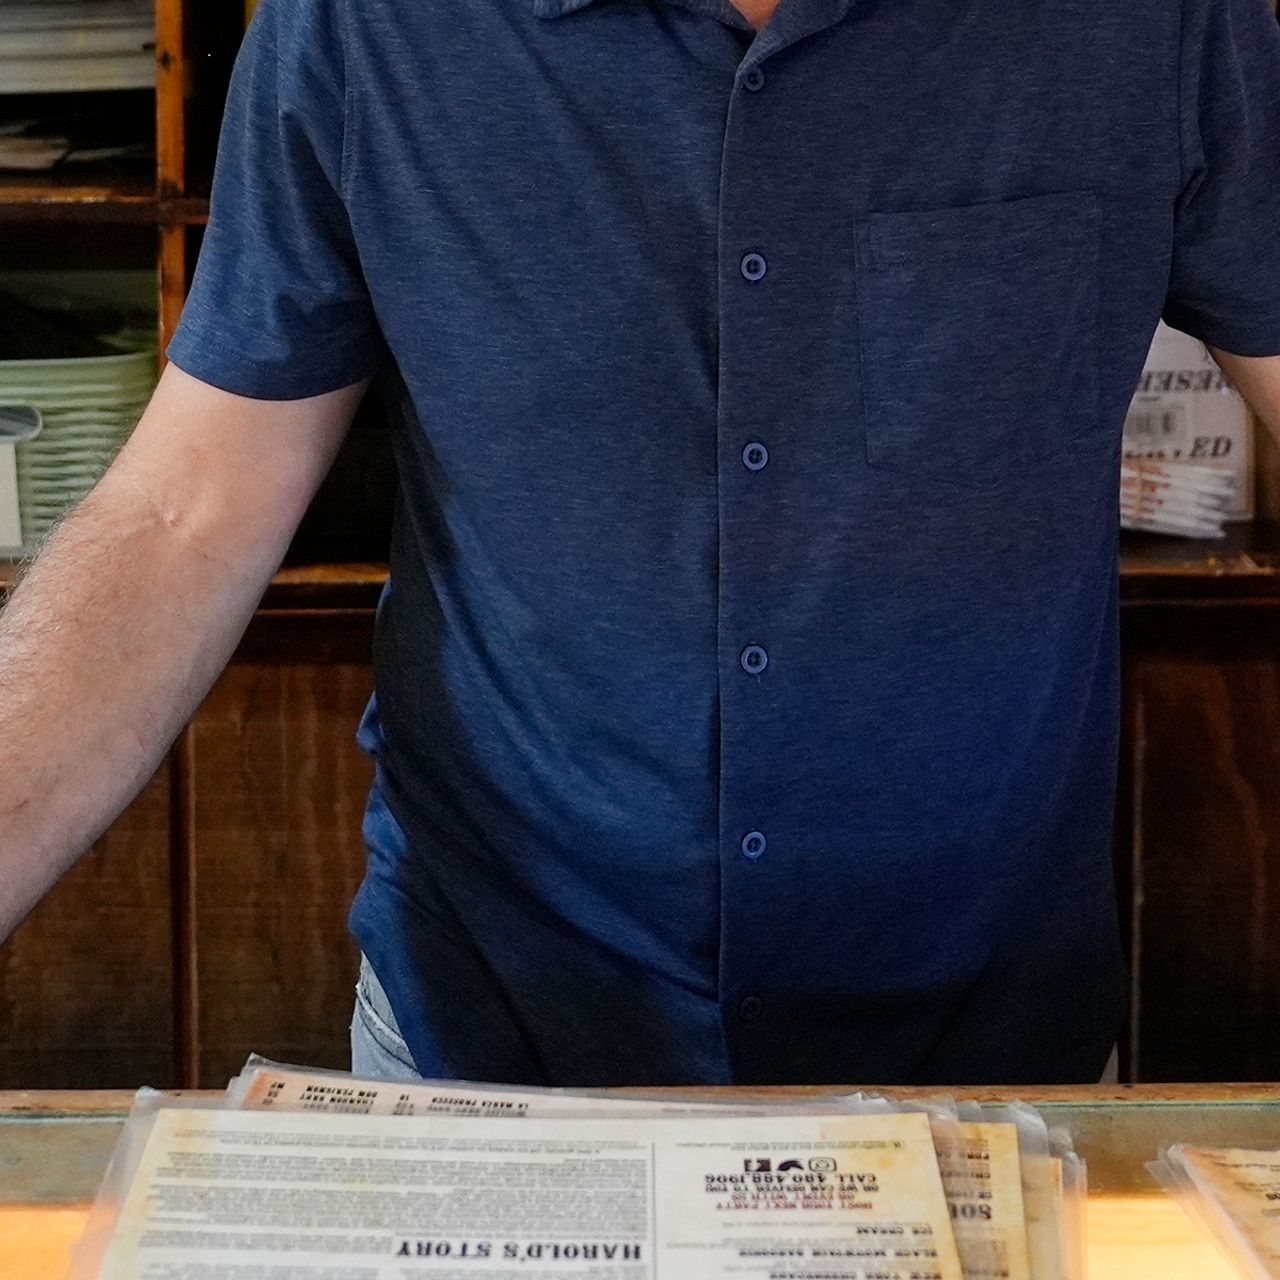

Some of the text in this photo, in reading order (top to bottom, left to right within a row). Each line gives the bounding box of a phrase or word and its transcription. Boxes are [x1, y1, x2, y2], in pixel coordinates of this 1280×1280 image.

[835, 1173, 876, 1183] CALL
[396, 1241, 642, 1262] HAROLD'S STORY
